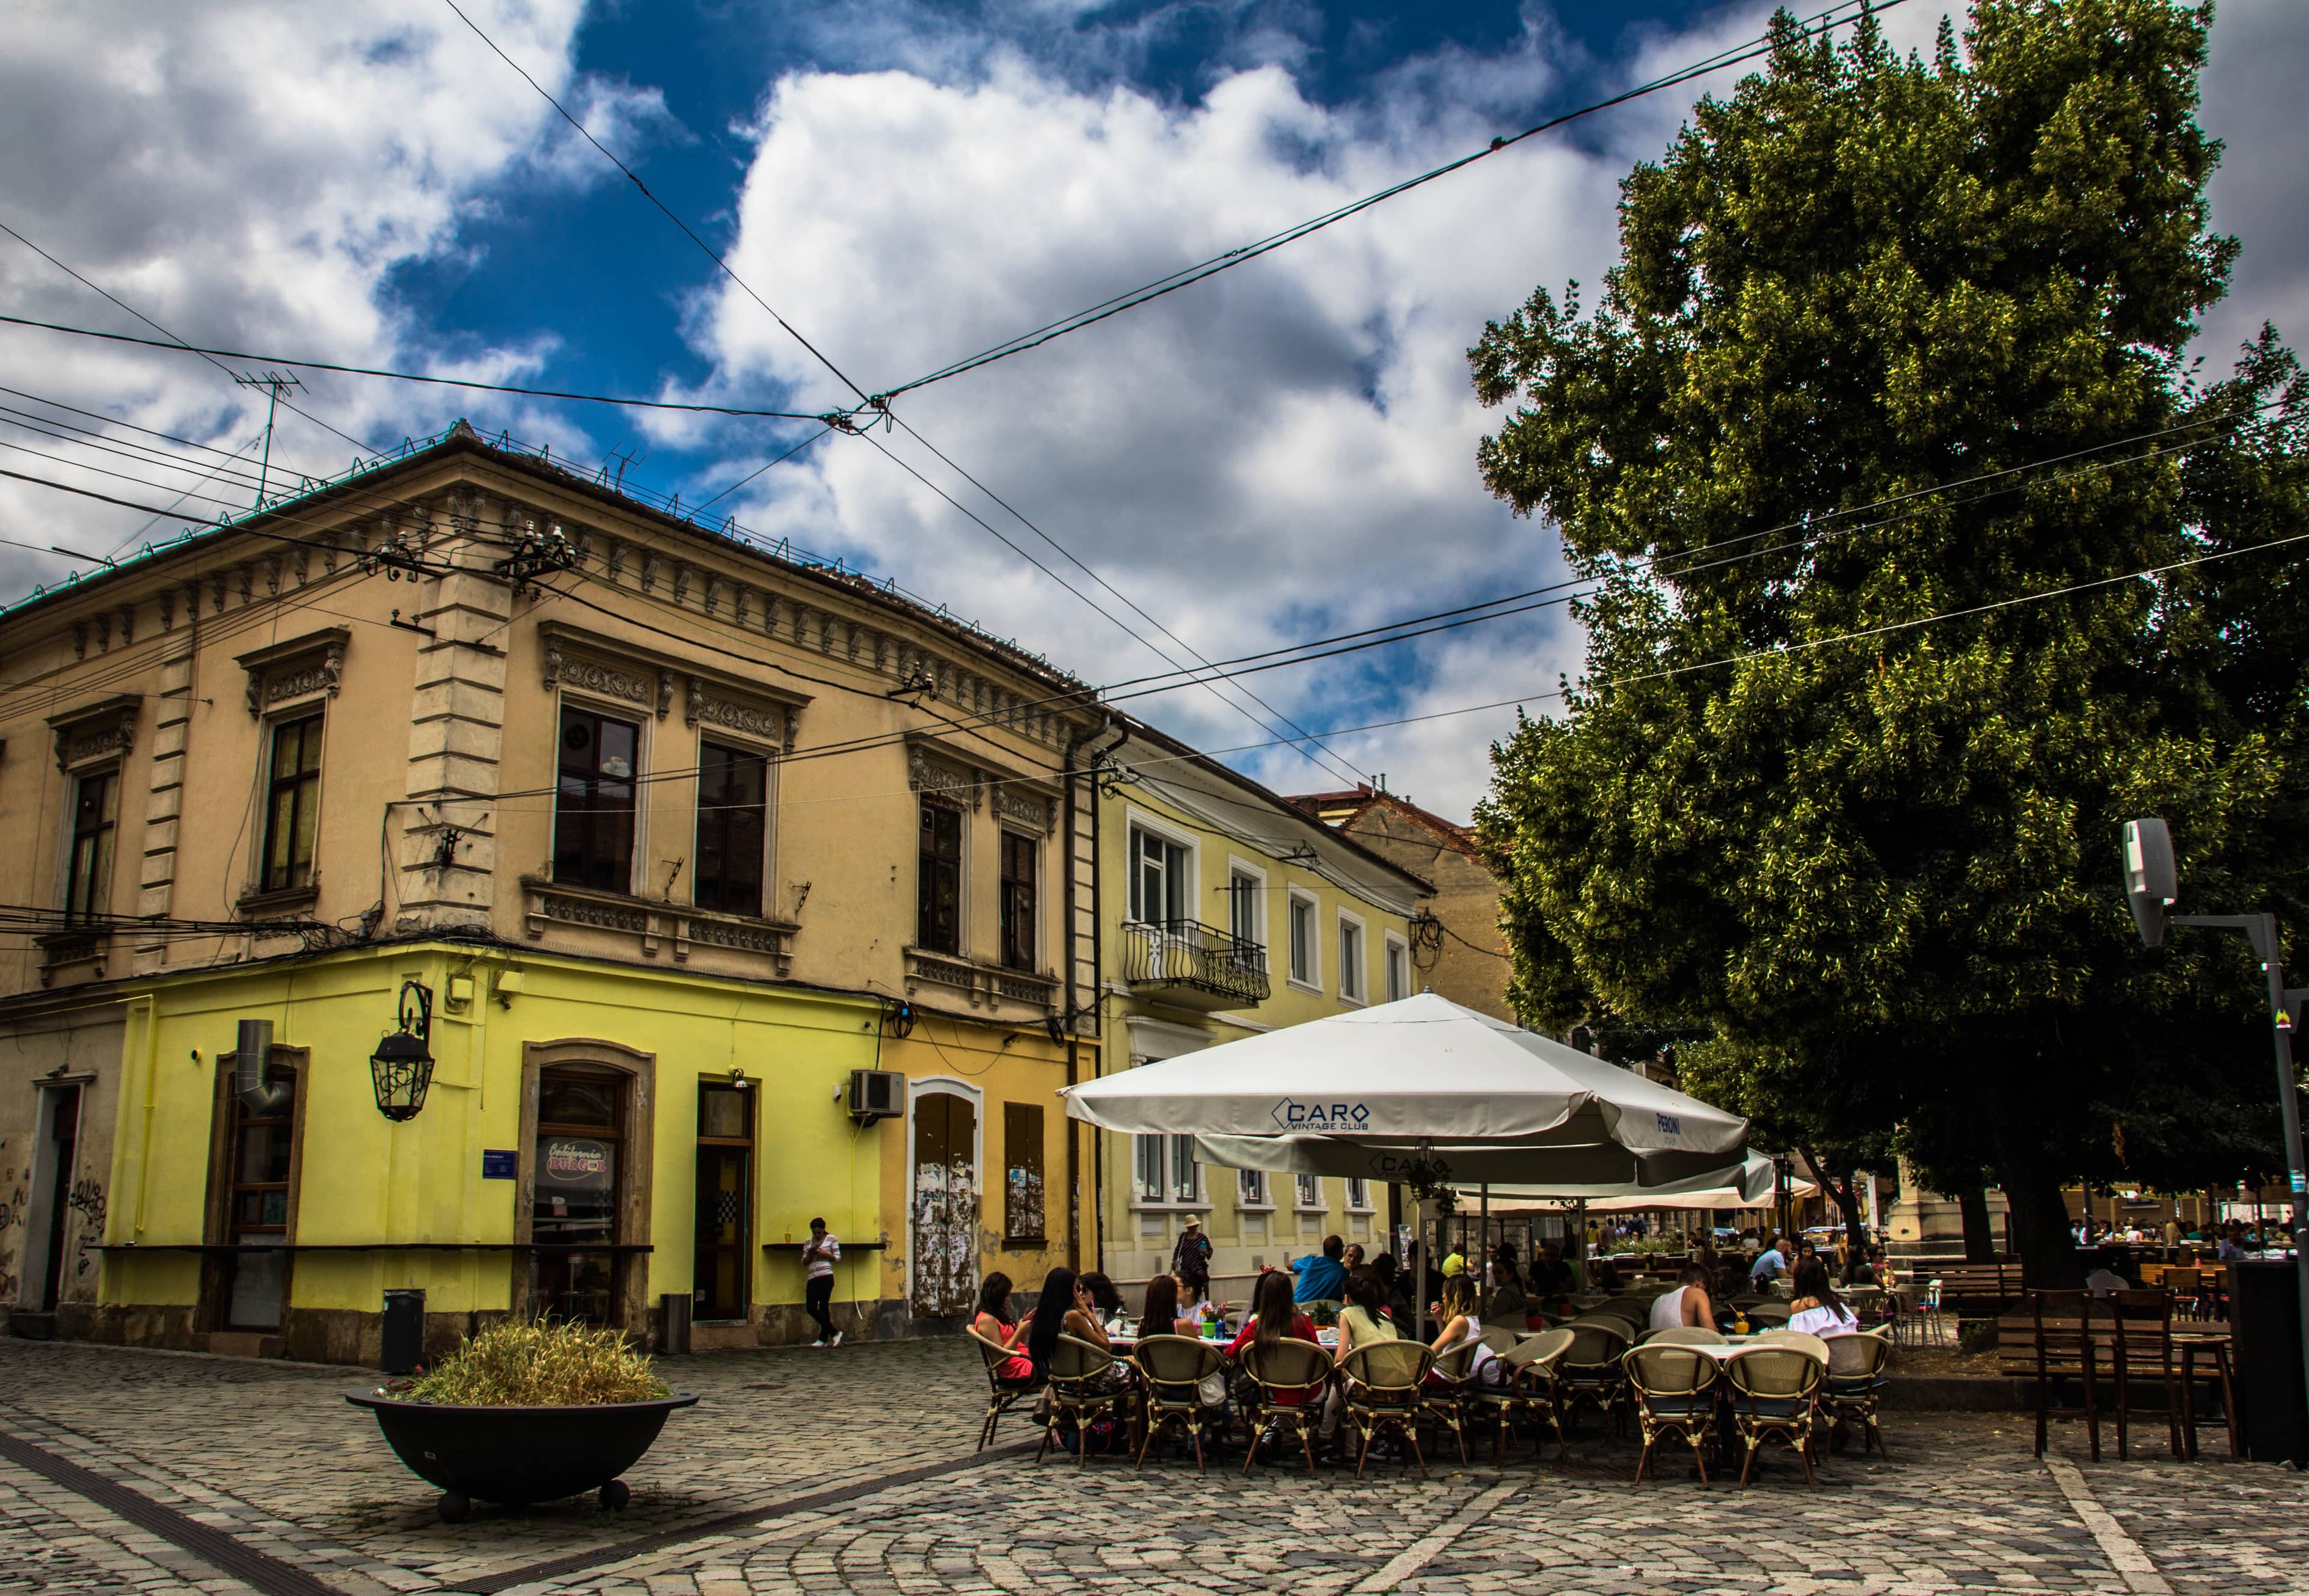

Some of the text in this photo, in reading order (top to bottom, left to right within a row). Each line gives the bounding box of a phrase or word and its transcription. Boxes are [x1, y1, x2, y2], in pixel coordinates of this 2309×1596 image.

[1287, 1103, 1370, 1123] CARO
[1657, 1113, 1680, 1135] PERONI
[549, 1143, 602, 1162] California
[1382, 1158, 1447, 1174] CAO
